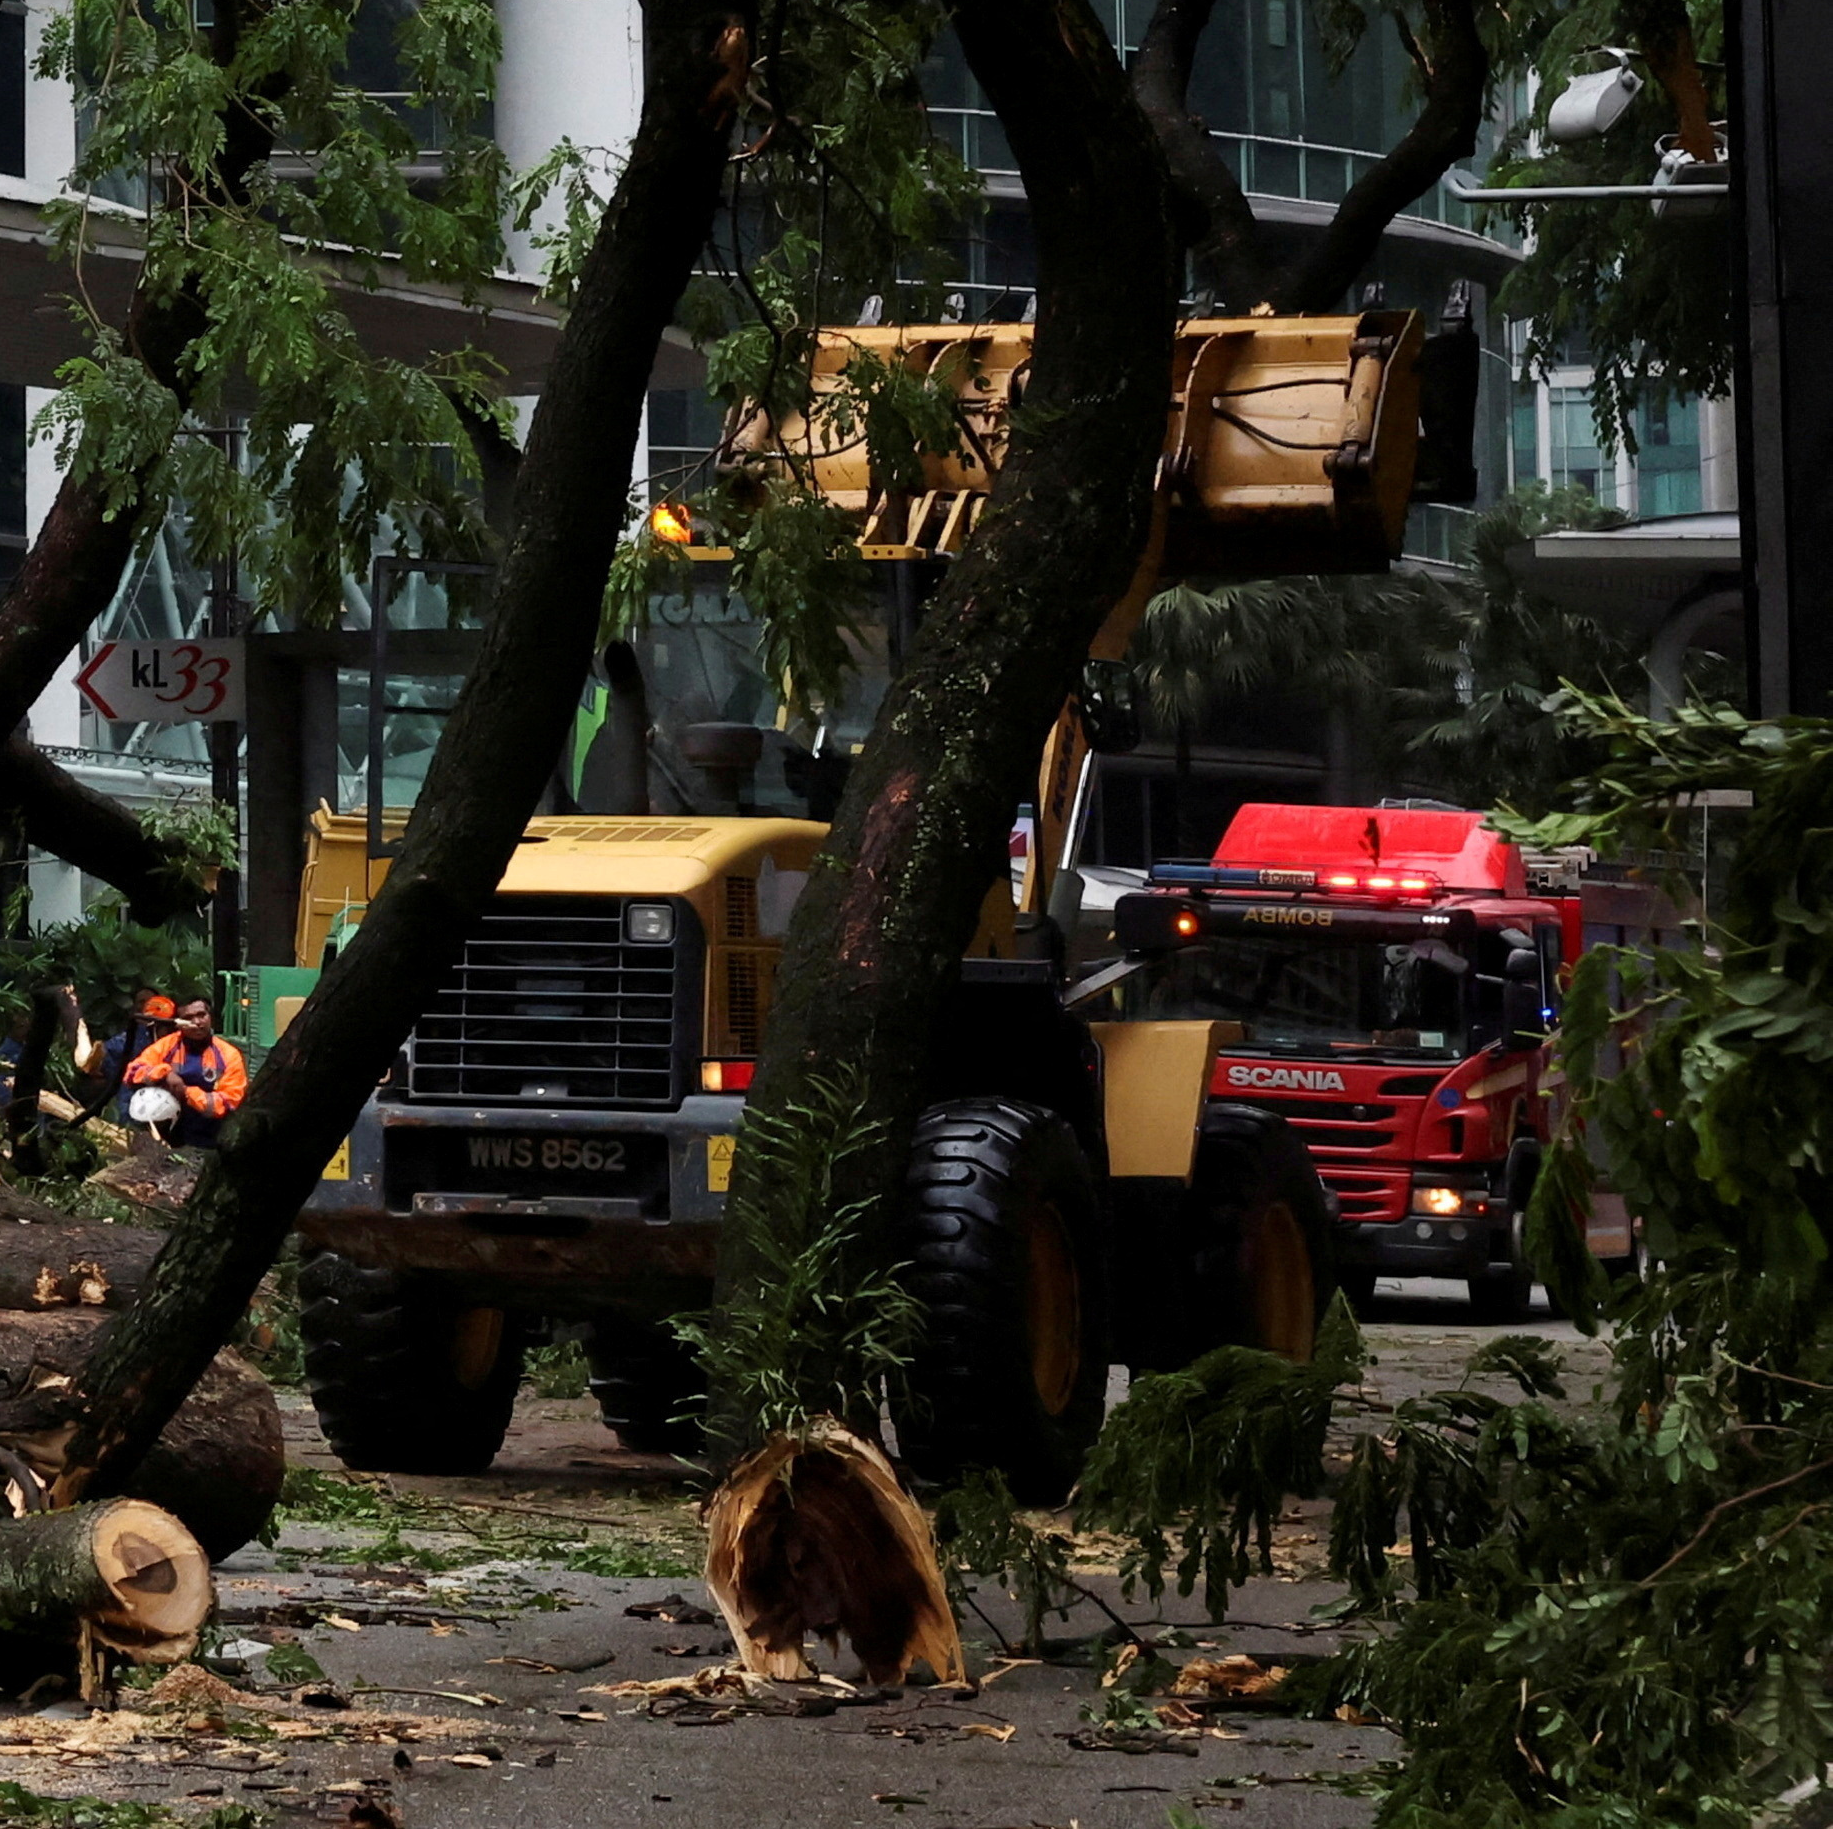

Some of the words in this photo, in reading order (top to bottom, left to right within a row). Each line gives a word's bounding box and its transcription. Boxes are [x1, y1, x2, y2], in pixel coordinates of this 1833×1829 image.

[1227, 1066, 1346, 1091] SCANIA
[468, 1137, 533, 1168] WWS
[541, 1138, 627, 1171] 8562
